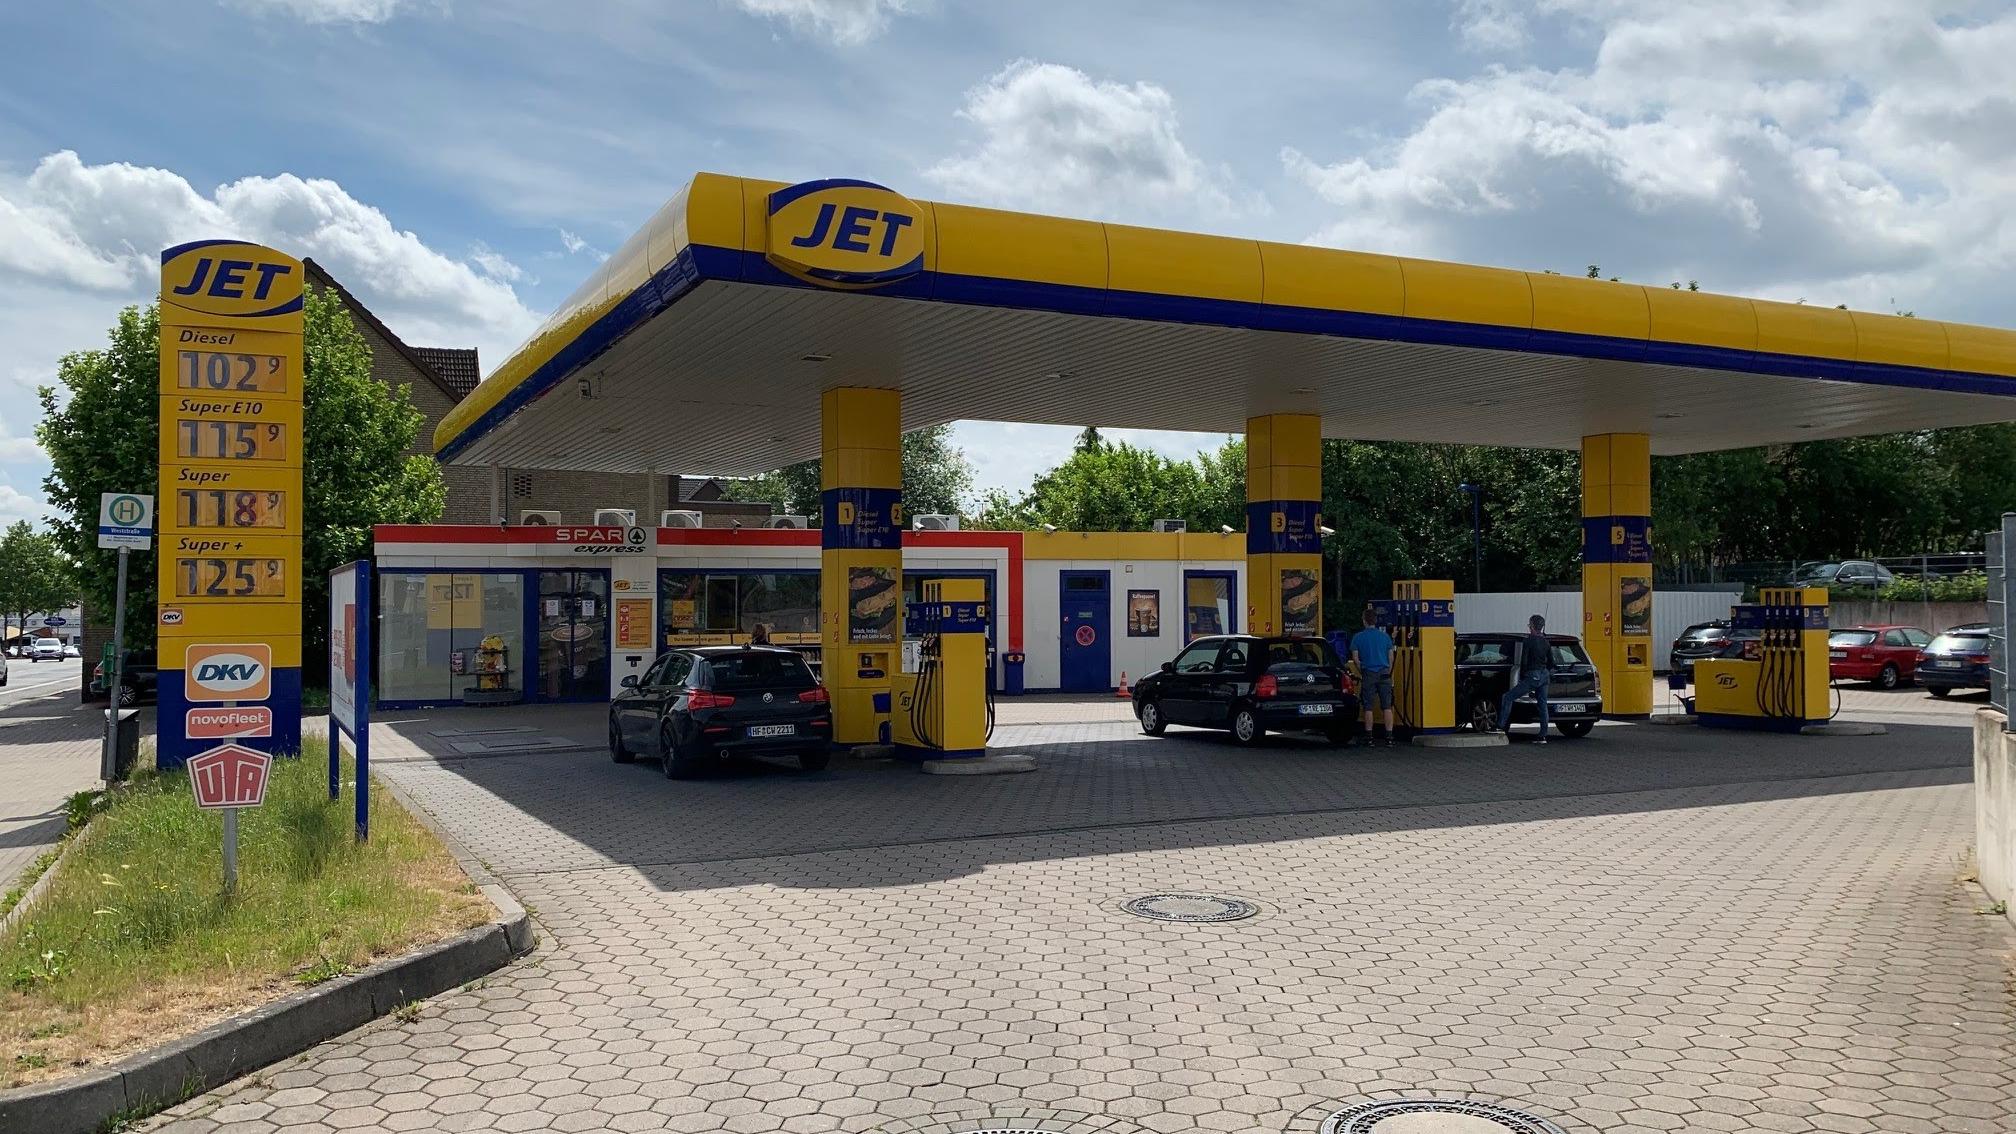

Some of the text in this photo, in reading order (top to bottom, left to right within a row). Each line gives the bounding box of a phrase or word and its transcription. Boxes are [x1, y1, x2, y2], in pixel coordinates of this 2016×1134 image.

[791, 203, 913, 257] JET
[173, 258, 291, 300] JET
[178, 329, 235, 346] Diesel
[178, 399, 263, 416] Super E10
[178, 468, 231, 486] Super
[119, 502, 135, 519] H
[844, 508, 850, 519] 1
[1276, 517, 1283, 528] 3
[556, 528, 623, 541] SPAR
[1616, 530, 1622, 540] 5
[177, 537, 230, 555] Super
[573, 544, 646, 555] express
[163, 614, 181, 622] DKV
[197, 663, 259, 681] DKV
[1717, 675, 1735, 686] JET
[901, 693, 912, 708] JET
[191, 712, 265, 725] novofleet
[196, 747, 267, 803] UTA
